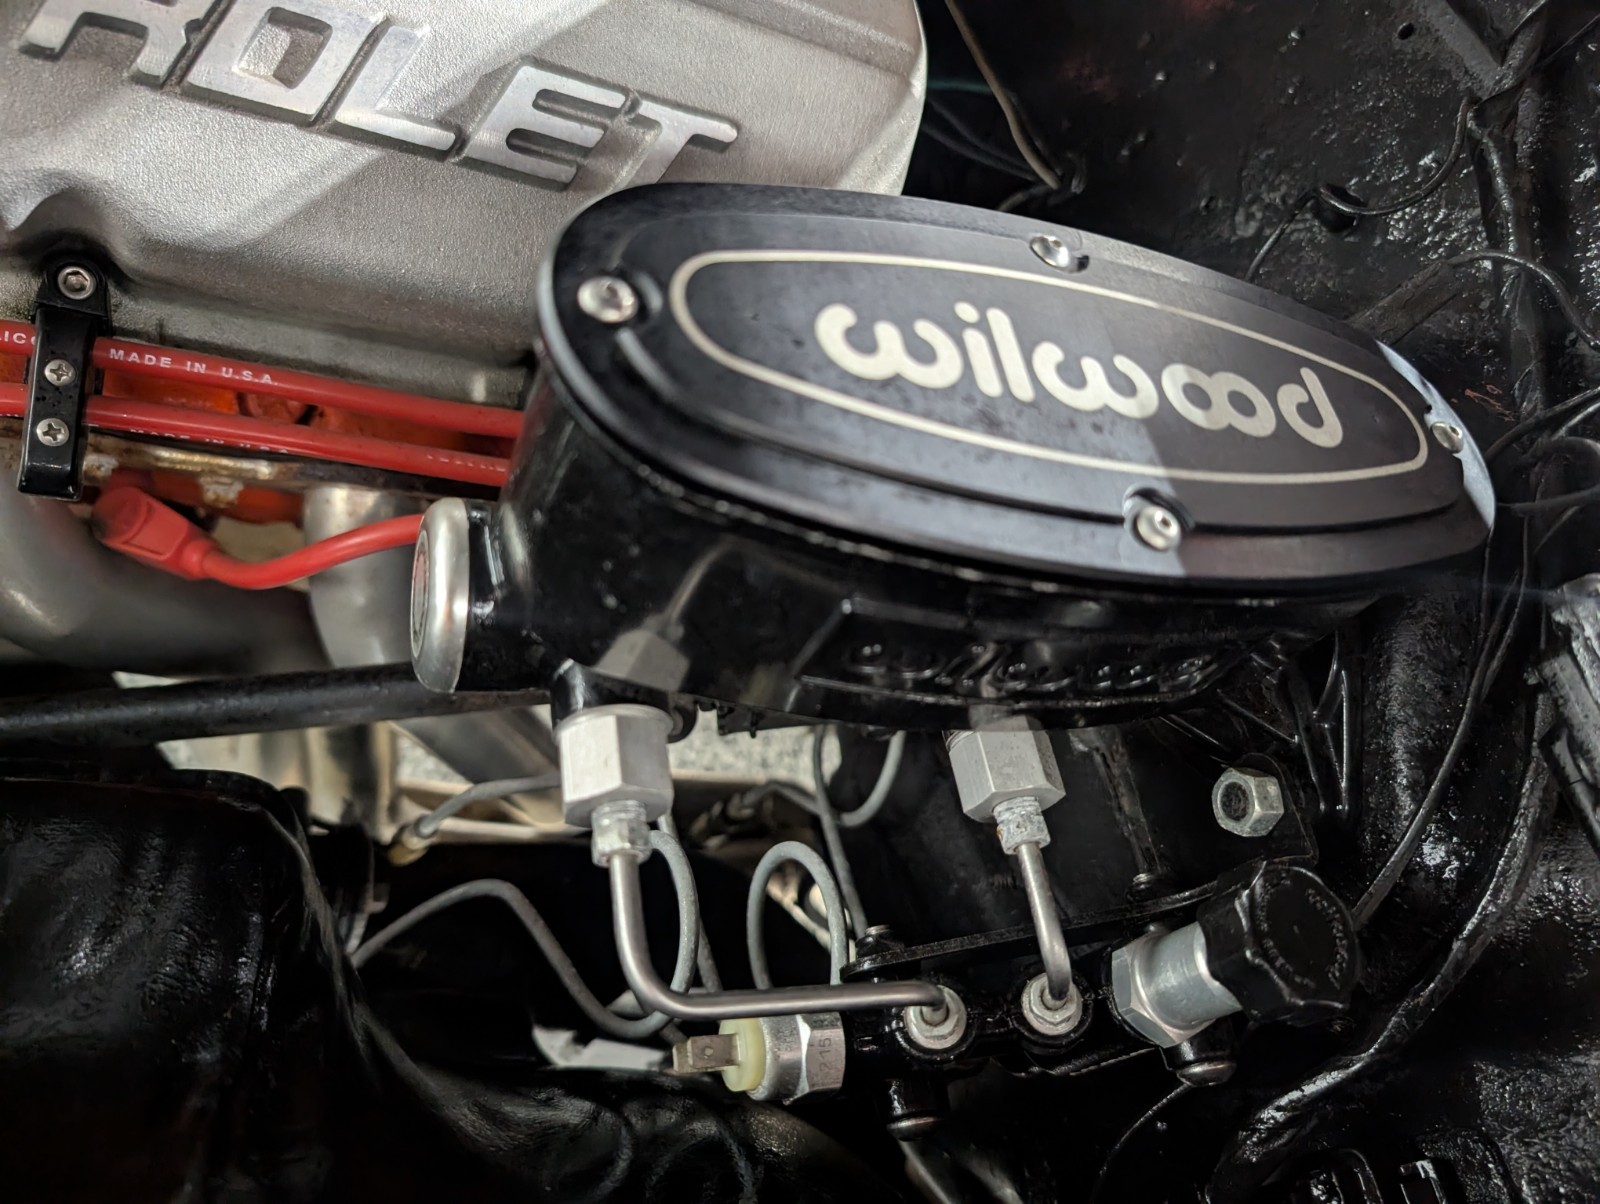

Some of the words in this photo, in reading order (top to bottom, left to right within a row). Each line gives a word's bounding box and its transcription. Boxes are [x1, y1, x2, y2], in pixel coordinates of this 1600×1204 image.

[109, 348, 172, 369] MADE
[185, 360, 207, 374] IN
[814, 301, 1344, 449] wilwood
